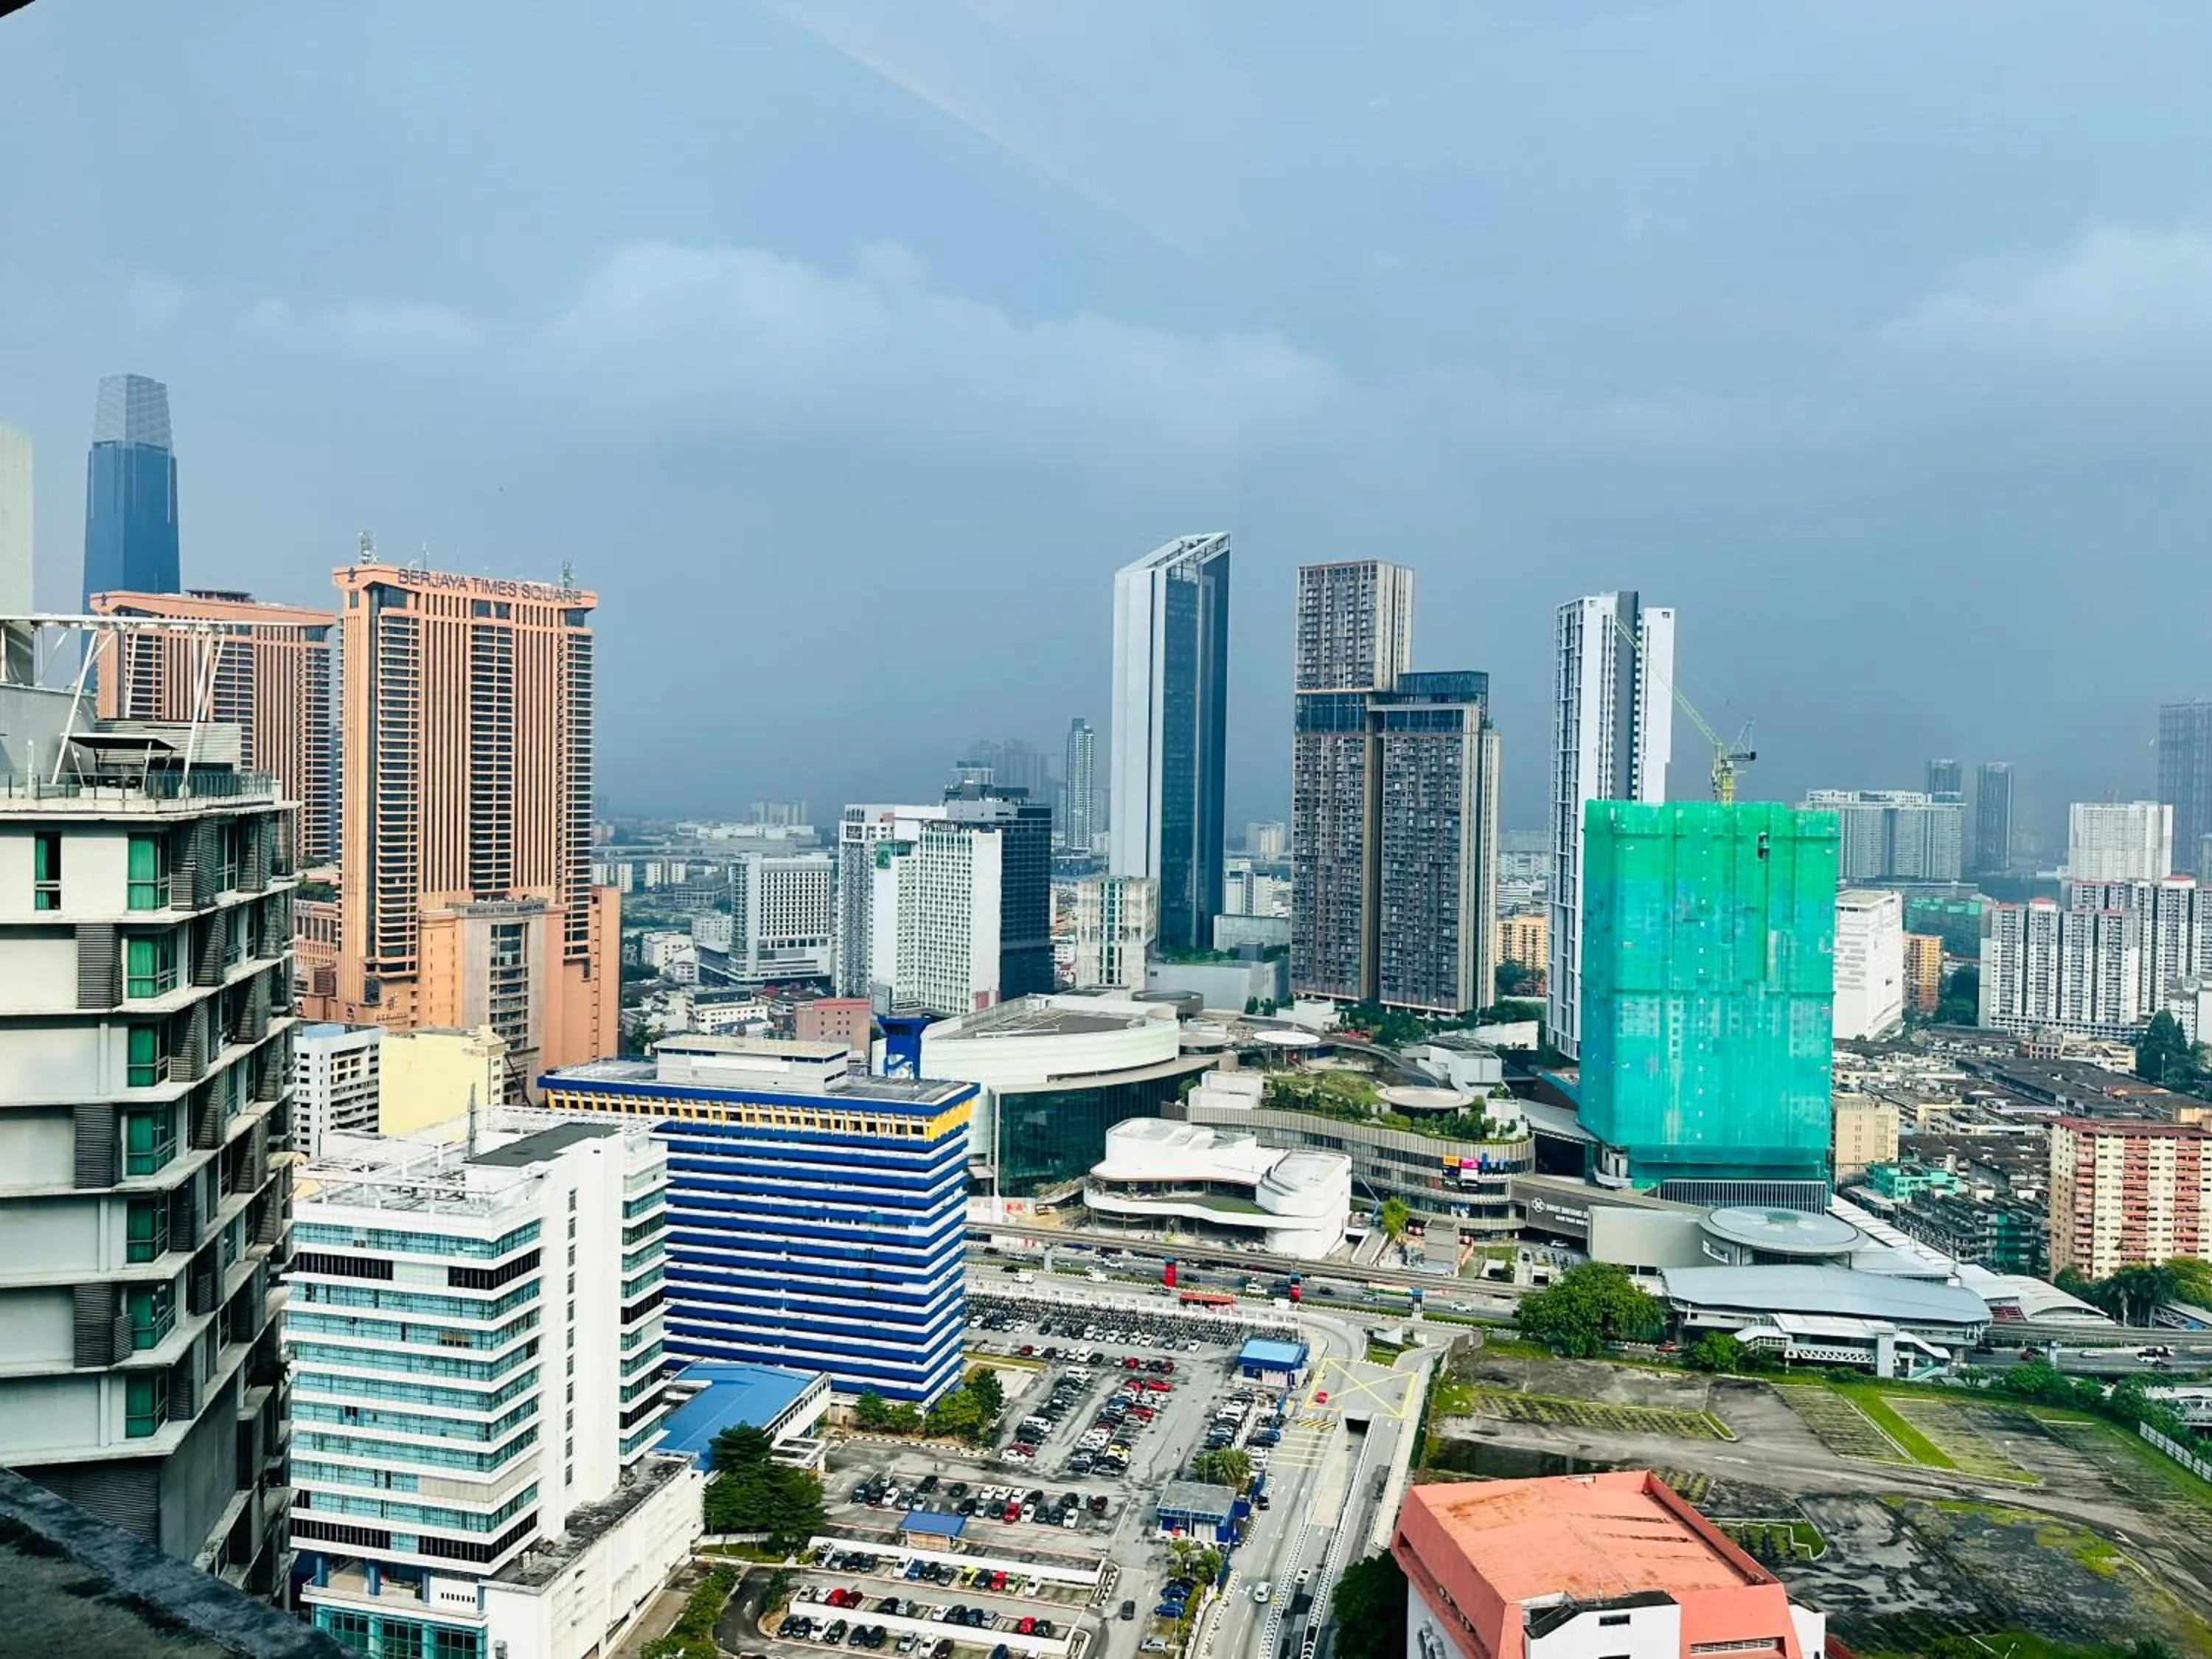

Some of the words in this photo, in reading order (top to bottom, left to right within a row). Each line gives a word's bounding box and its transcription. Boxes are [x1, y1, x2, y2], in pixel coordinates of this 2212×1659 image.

[398, 568, 468, 591] BERJAYA
[471, 577, 516, 597] TIMES
[521, 583, 582, 605] SQUARE
